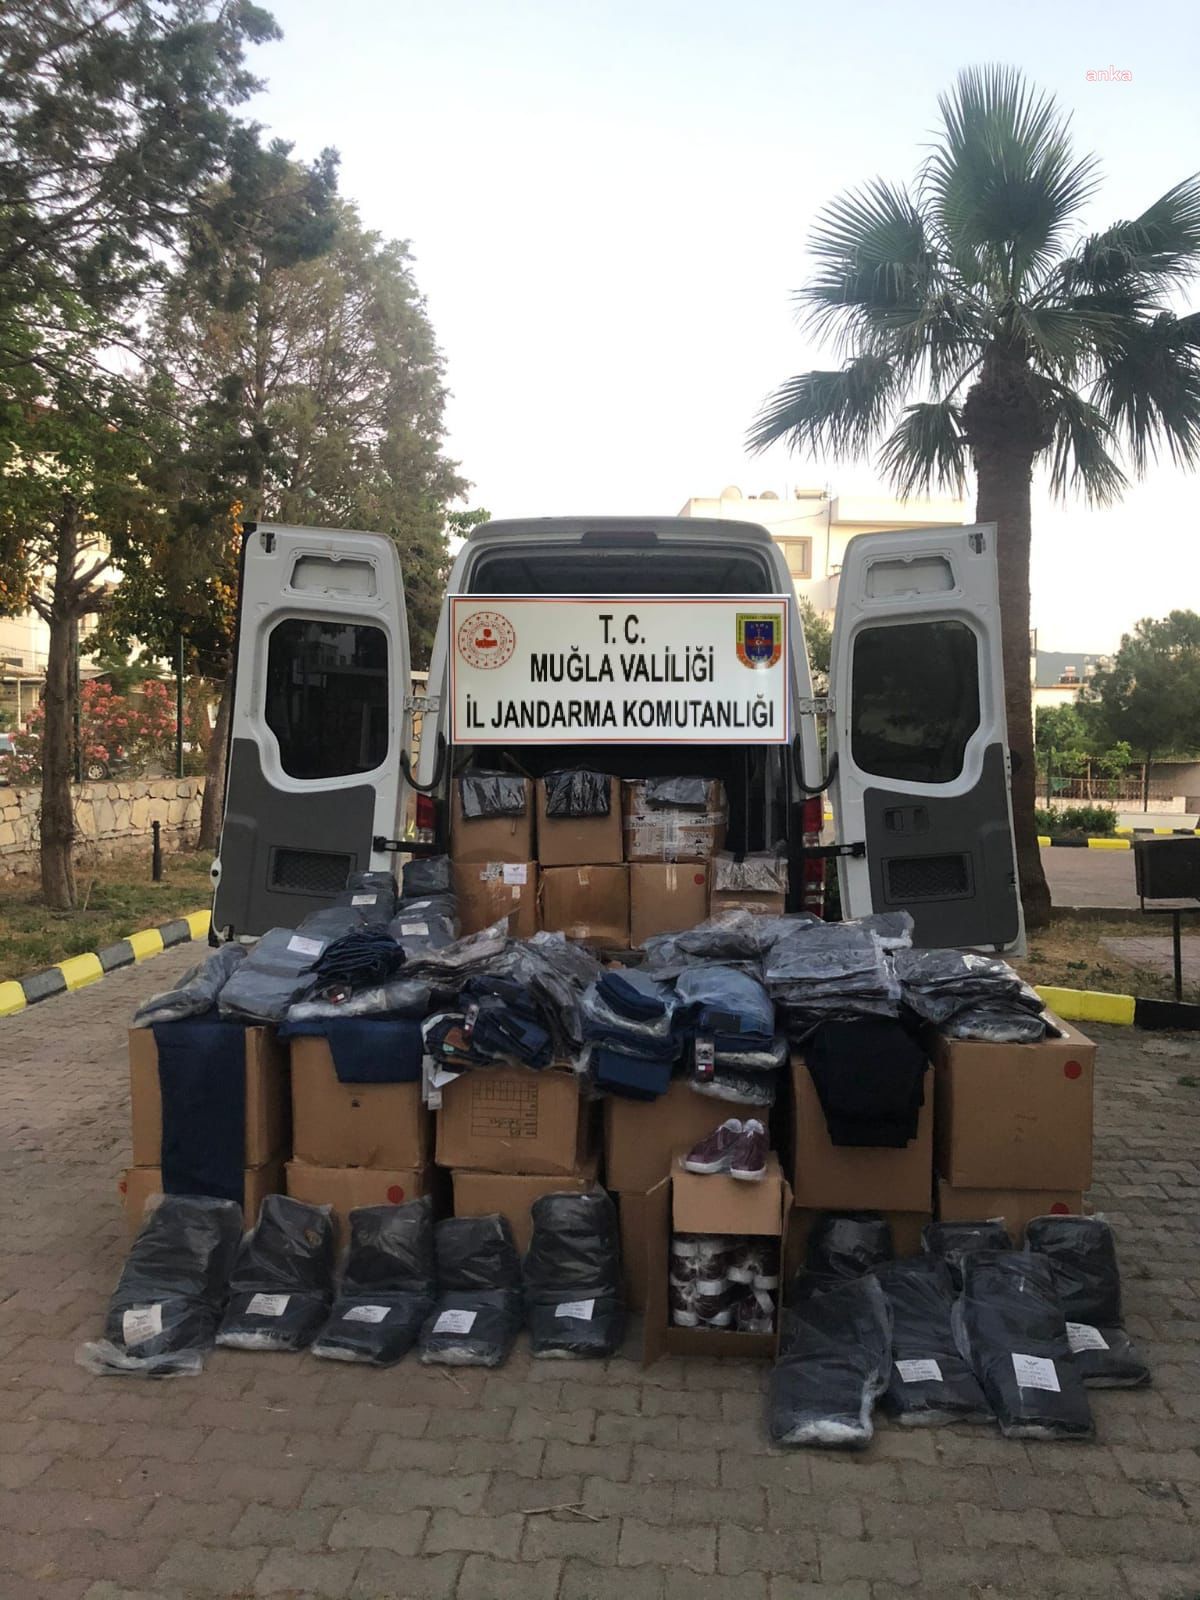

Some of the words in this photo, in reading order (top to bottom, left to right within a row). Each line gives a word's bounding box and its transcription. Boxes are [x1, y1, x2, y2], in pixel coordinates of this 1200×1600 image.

[599, 615, 616, 644] T.
[624, 614, 645, 644] C.
[531, 645, 614, 682] MUĞLA
[620, 646, 714, 682] VALİLİĞİ
[466, 694, 485, 728] İL
[491, 700, 617, 728] JANDARMA
[624, 693, 774, 728] KOMUTANLIĞI
